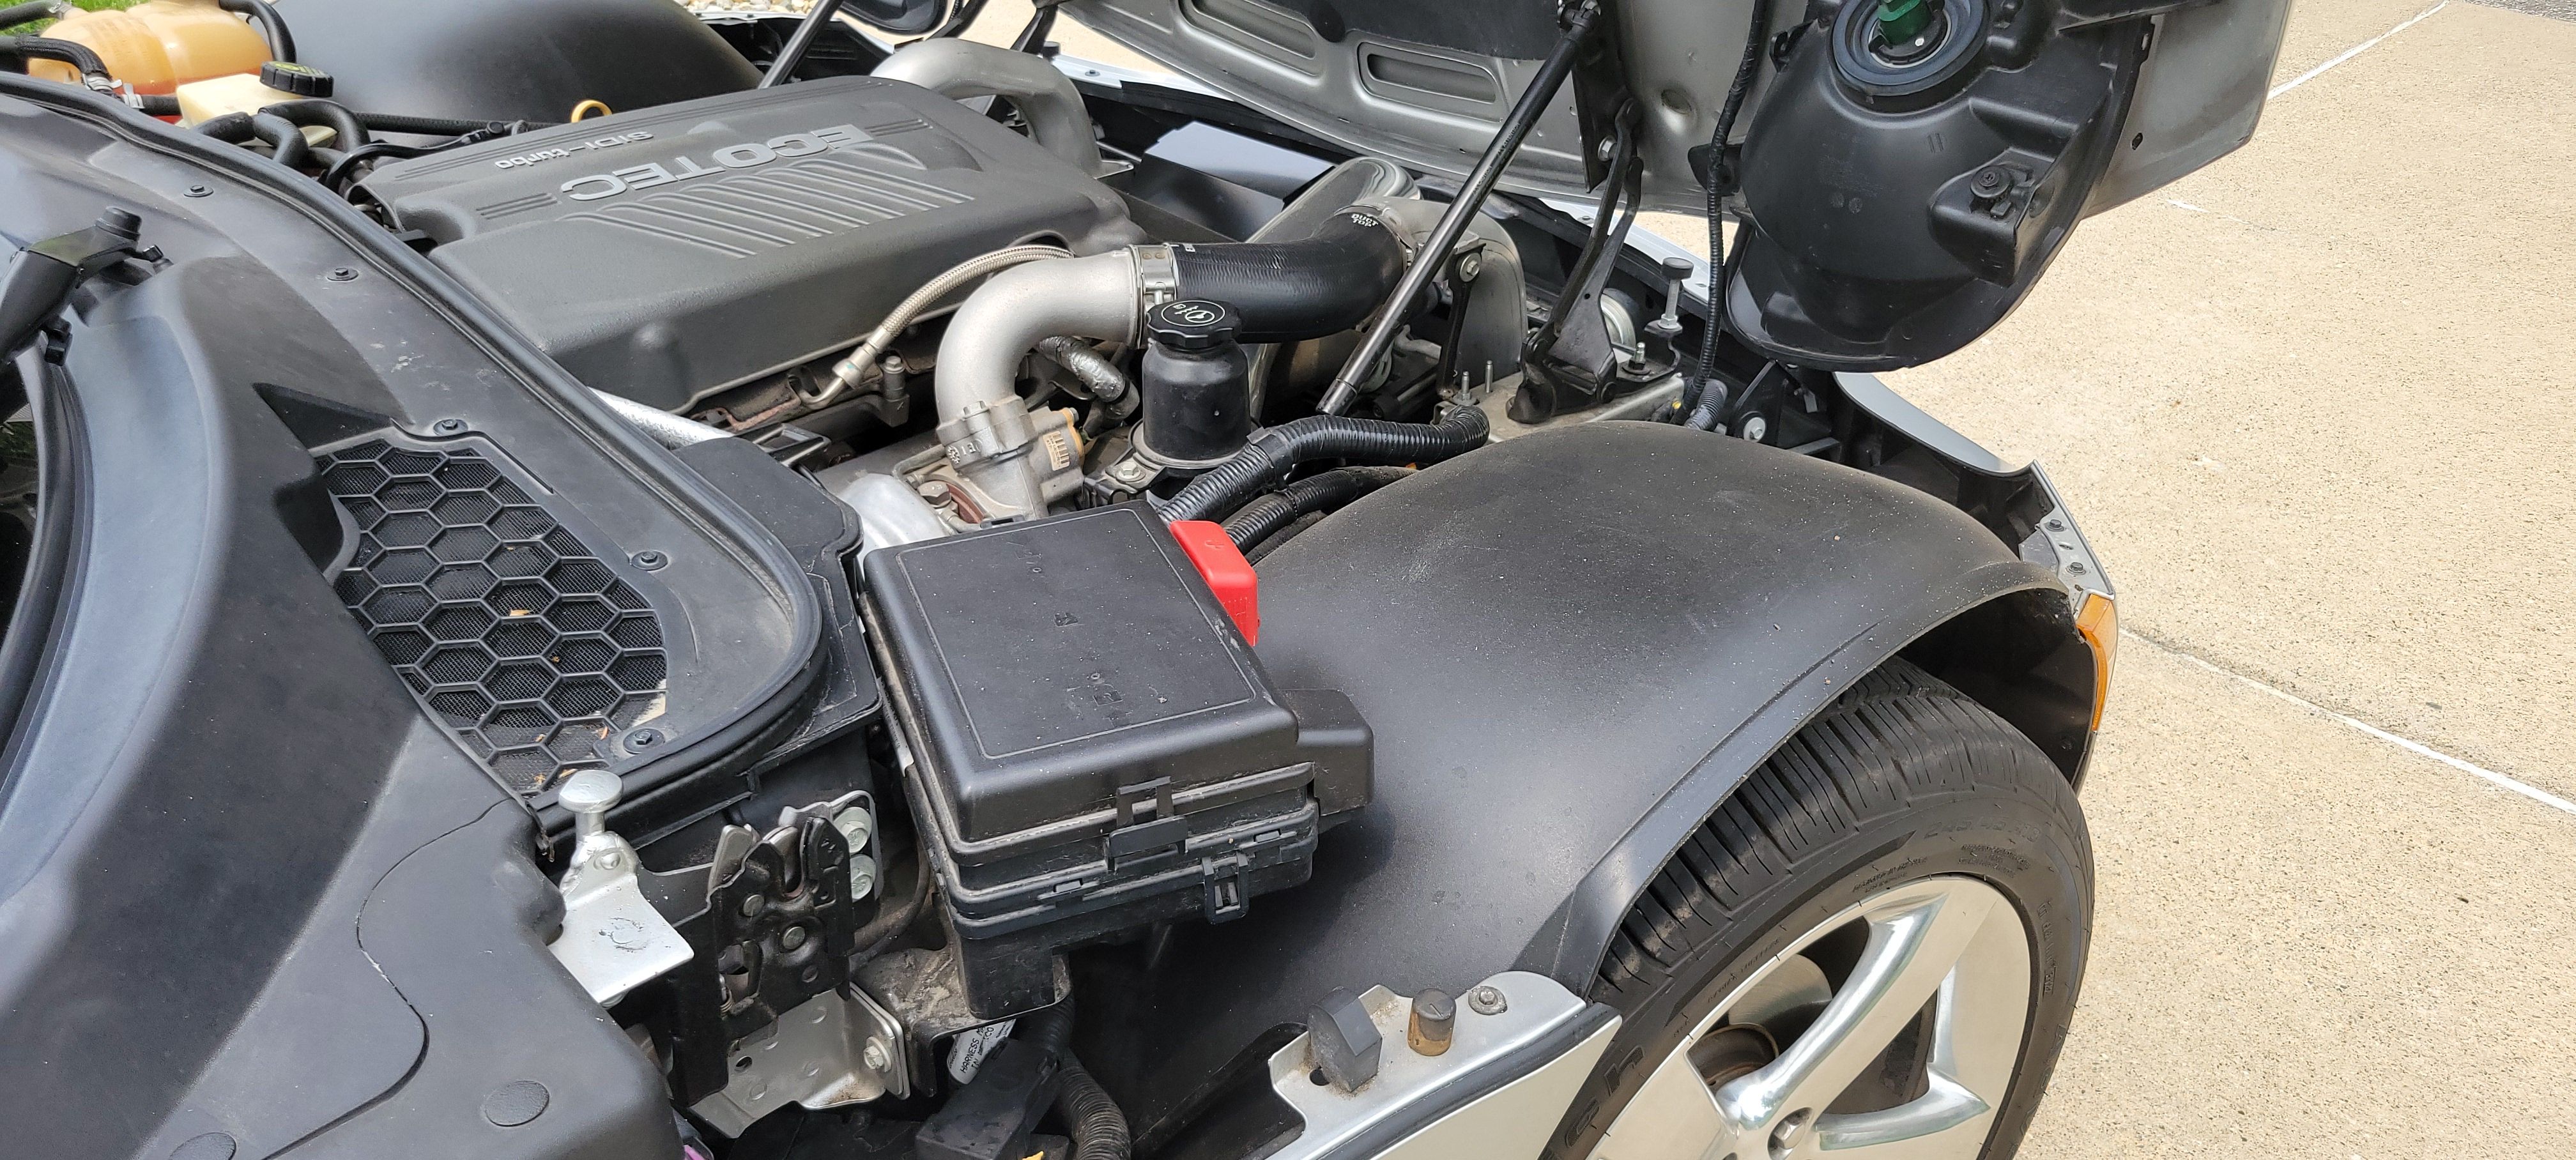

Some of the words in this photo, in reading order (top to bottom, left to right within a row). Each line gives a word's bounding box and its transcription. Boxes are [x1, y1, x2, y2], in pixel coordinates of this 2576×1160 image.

[561, 125, 874, 200] ECOTEC
[1351, 214, 1379, 226] DUCT
[1353, 218, 1372, 227] TOP
[960, 1038, 979, 1073] HARNESS
